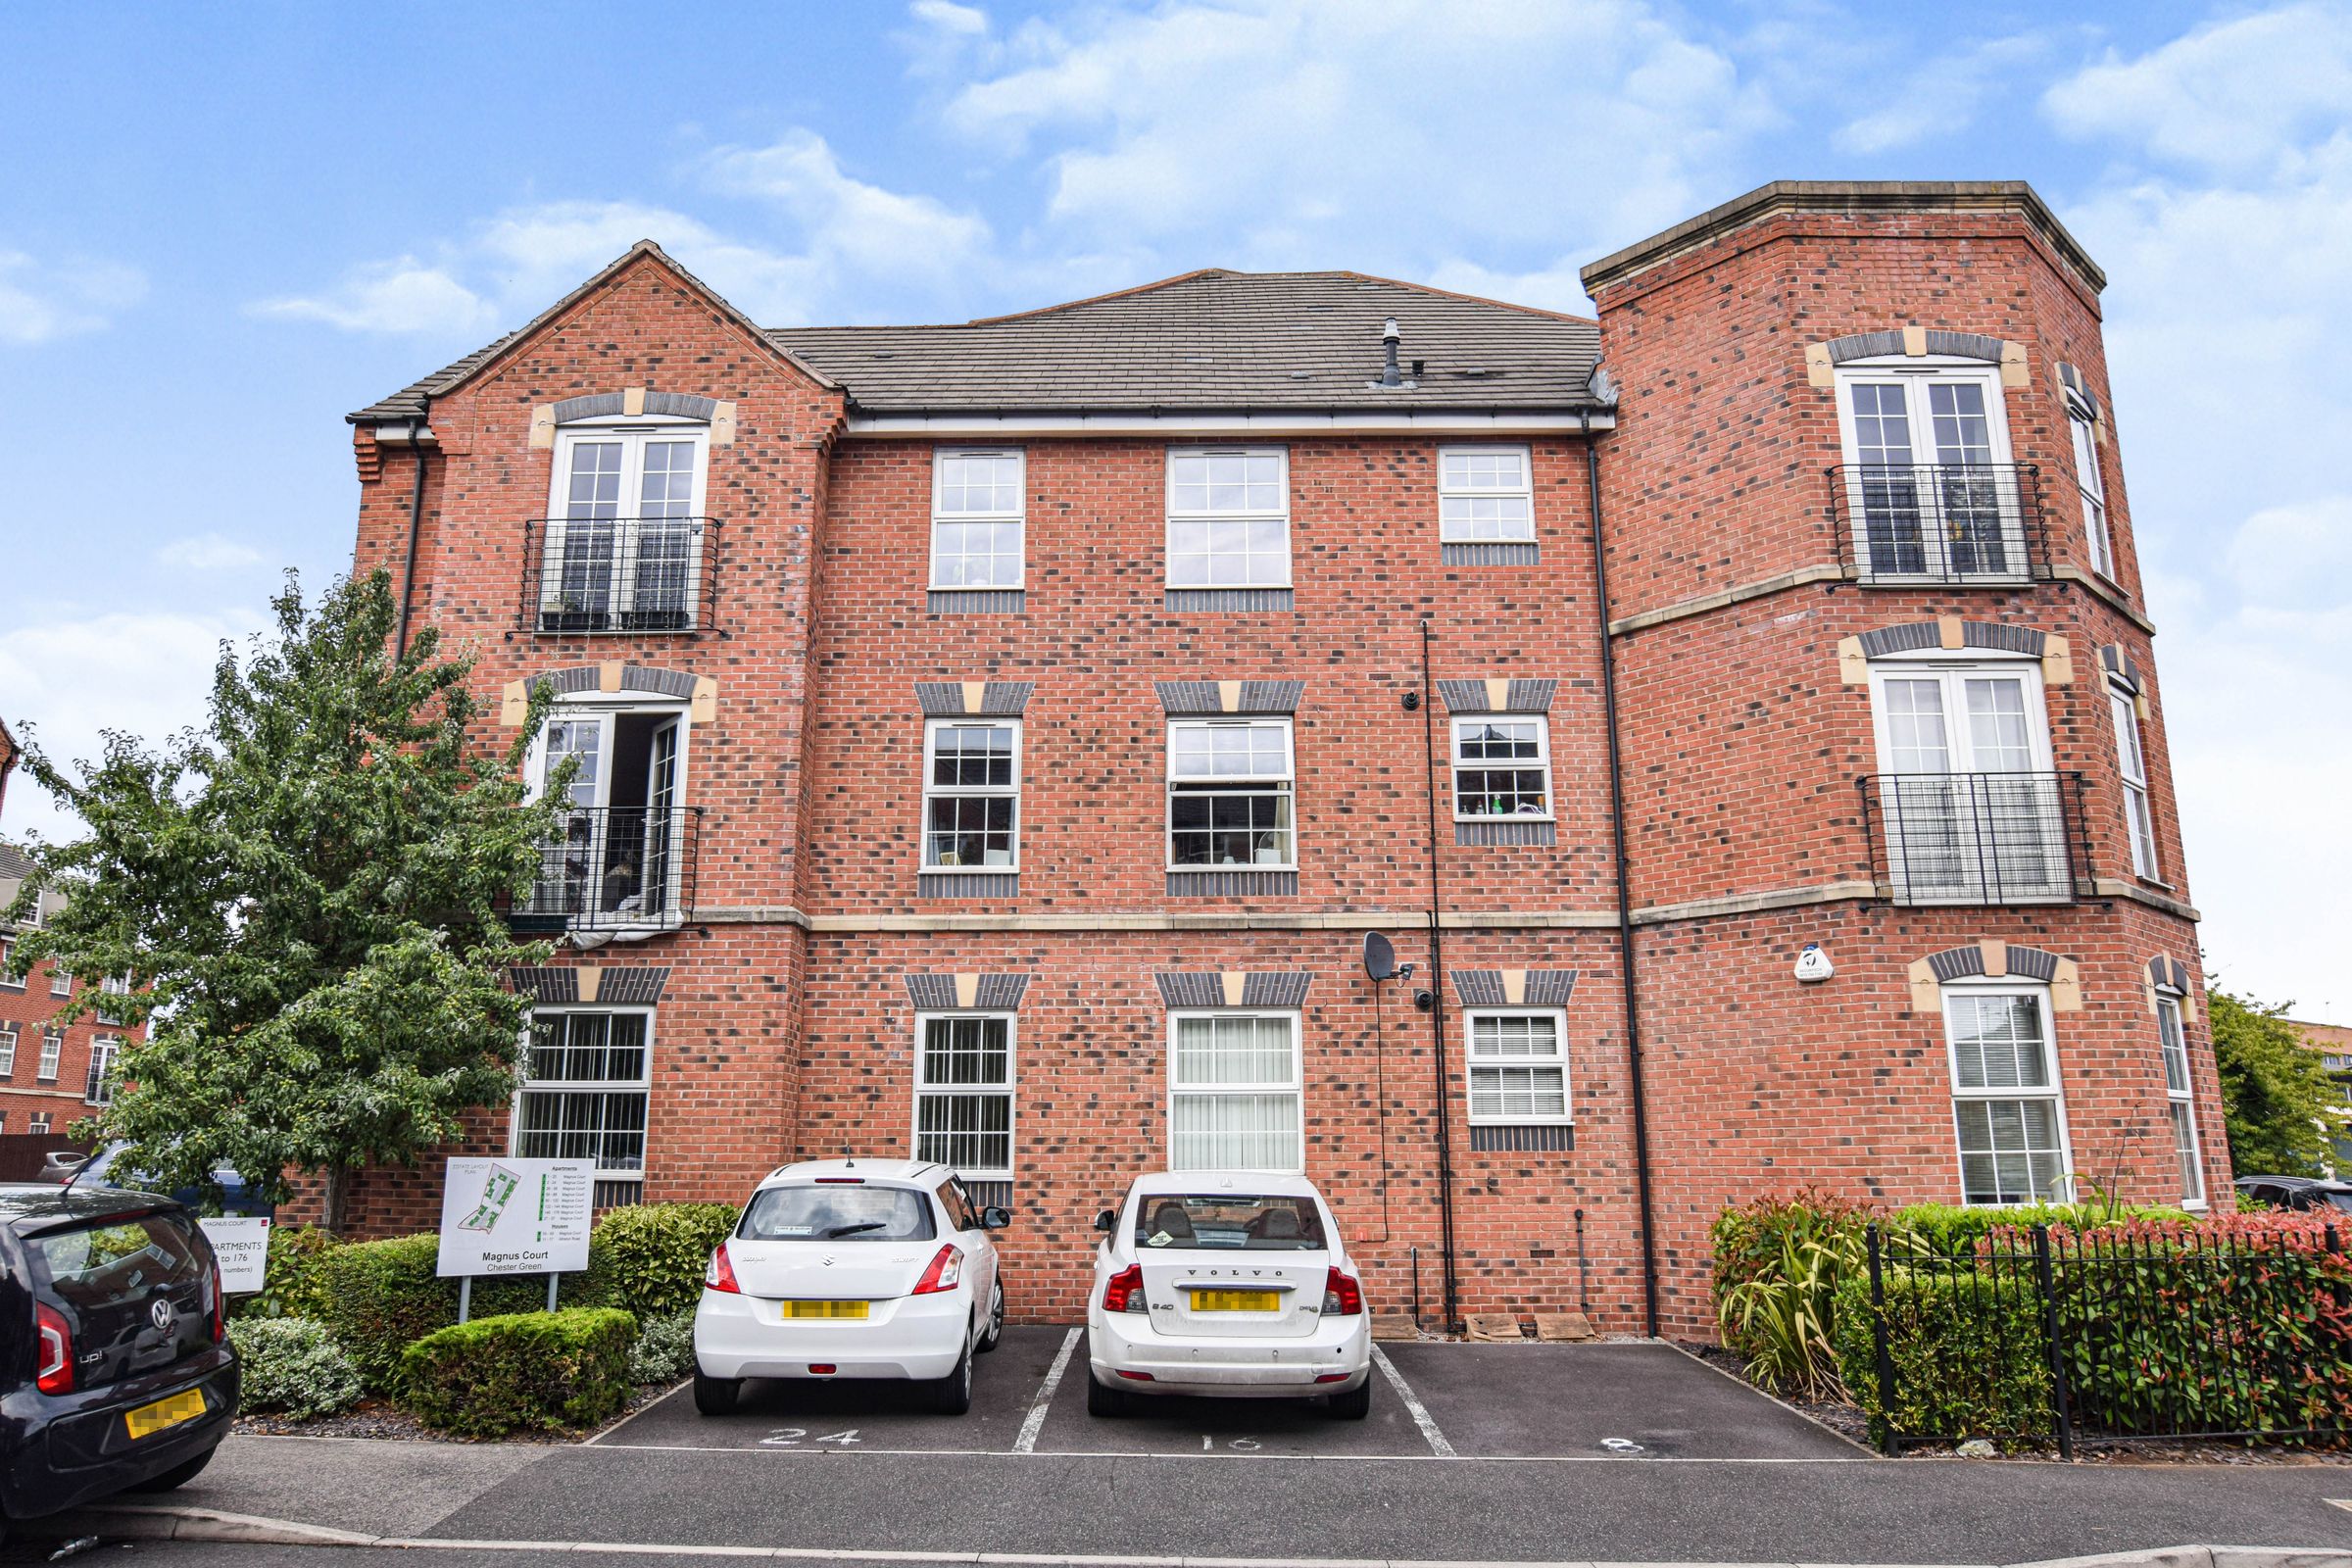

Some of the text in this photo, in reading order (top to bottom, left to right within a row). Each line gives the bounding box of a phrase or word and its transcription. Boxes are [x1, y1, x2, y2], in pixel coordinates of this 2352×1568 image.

[211, 1241, 262, 1251] PARTMENTS
[234, 1253, 247, 1262] 176
[482, 1251, 548, 1263] Magnus Court
[79, 1350, 102, 1364] up!
[759, 1428, 861, 1446] 24
